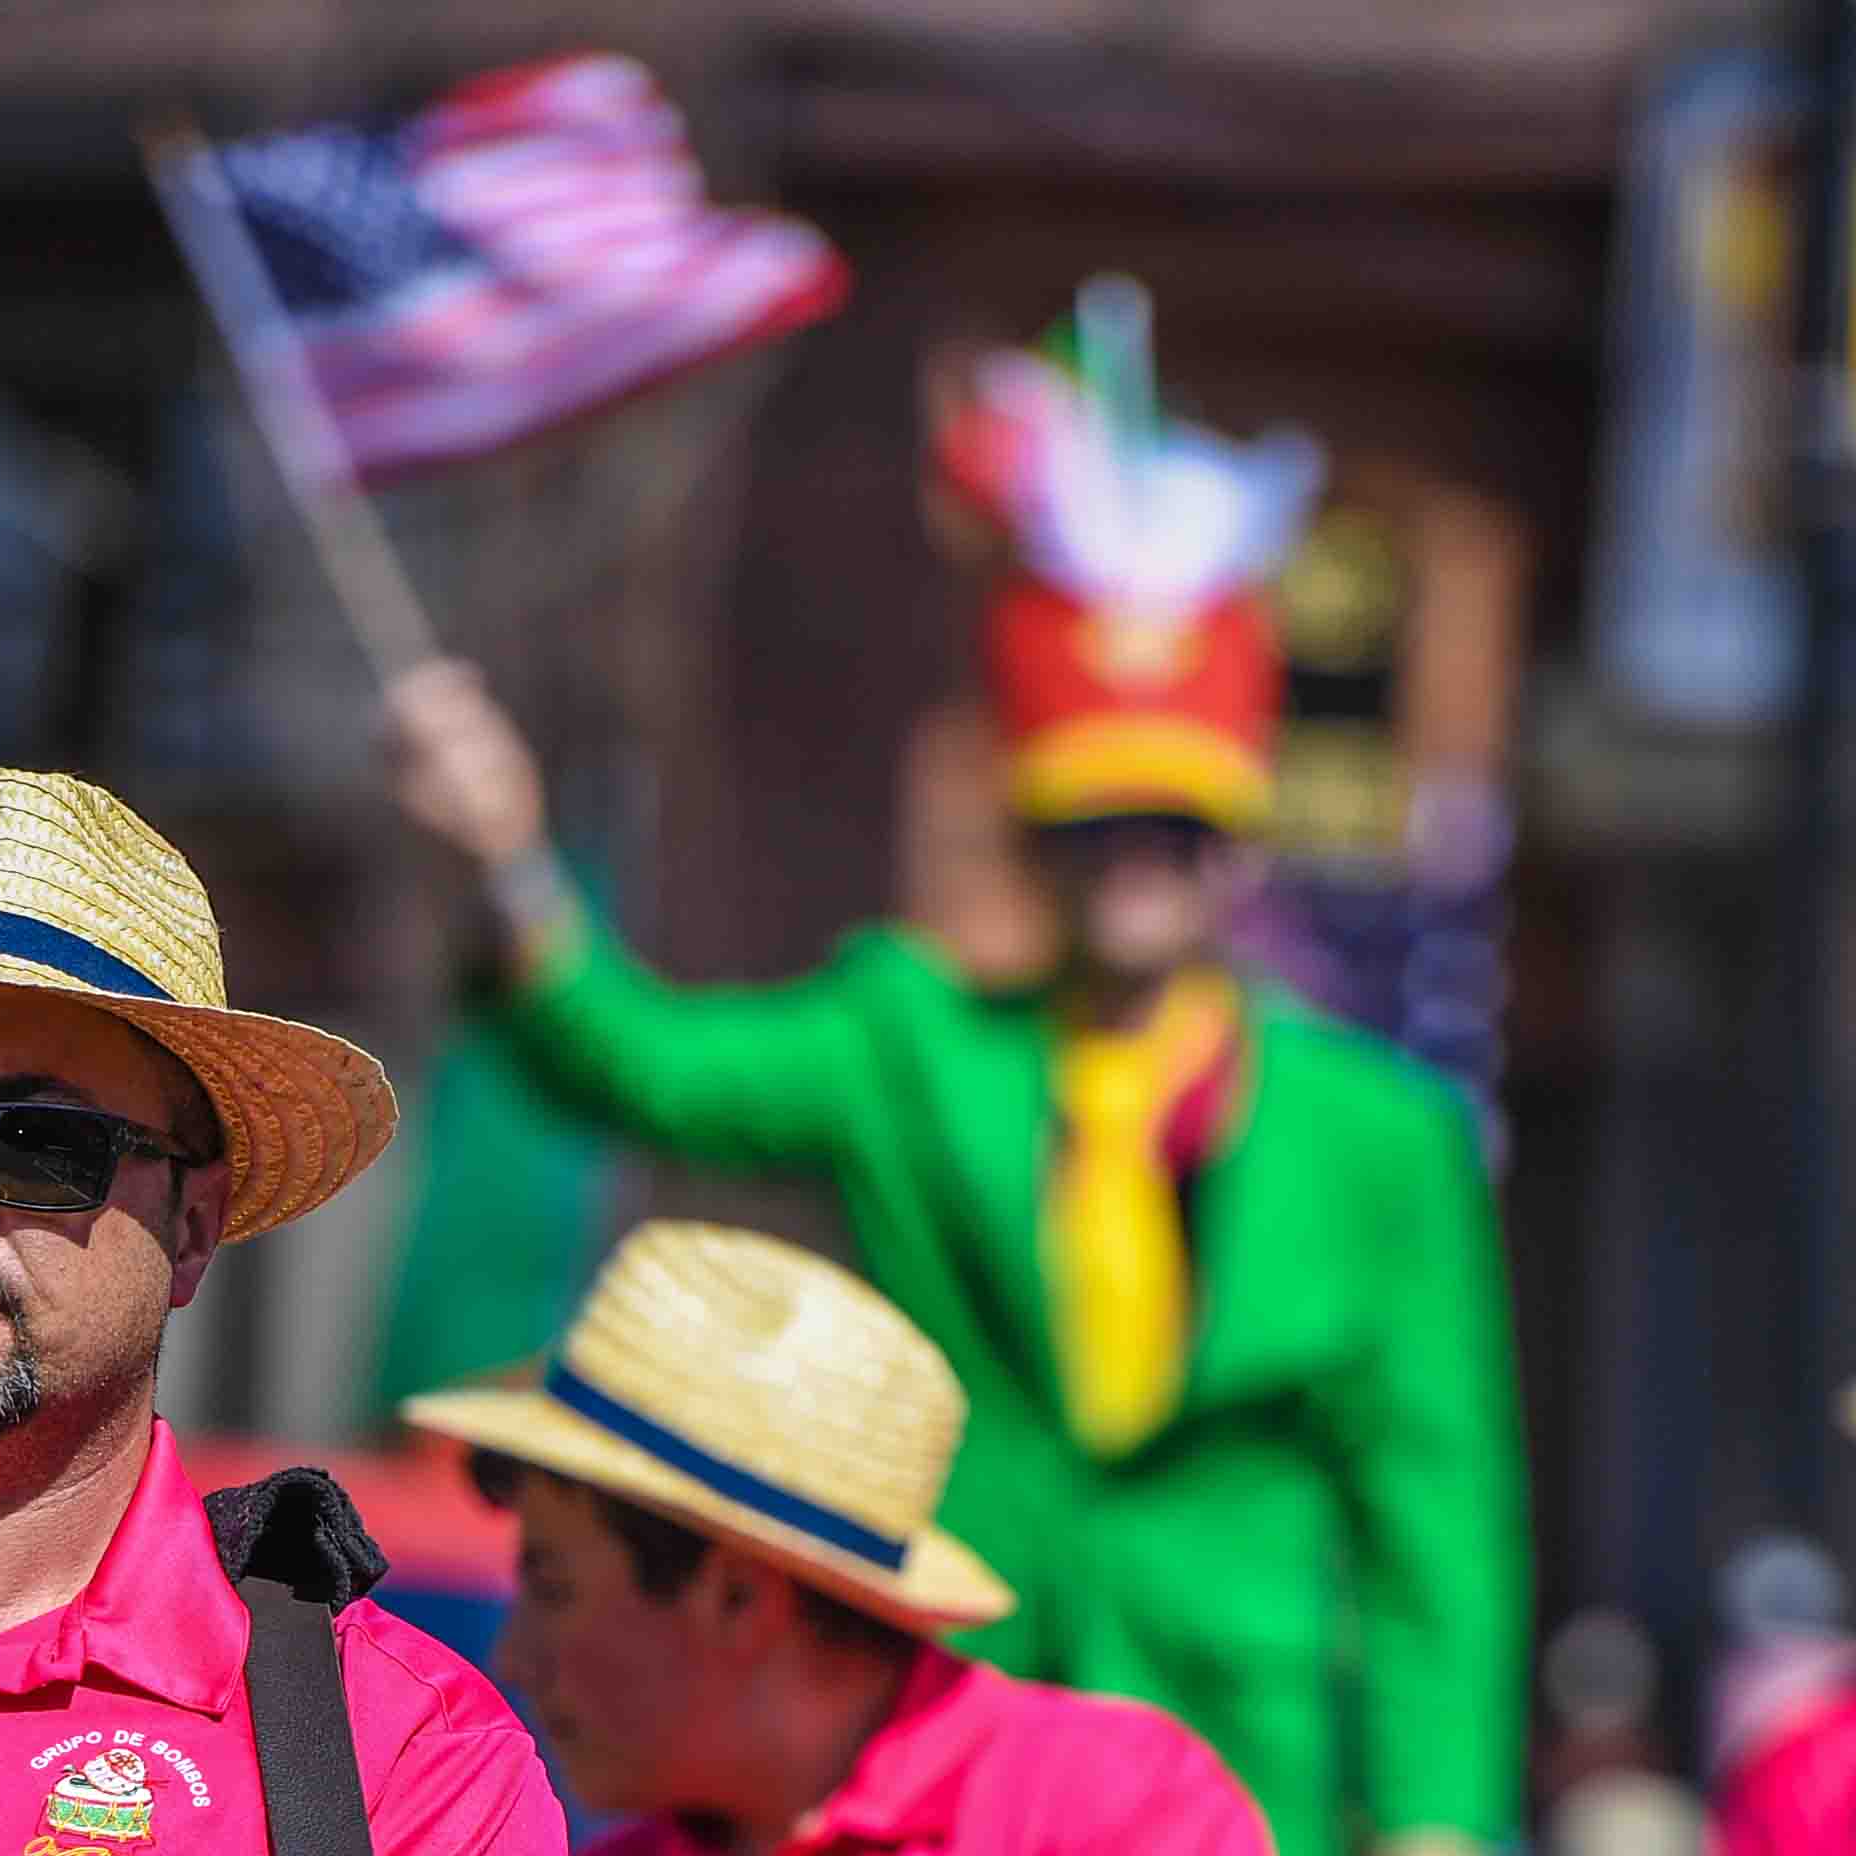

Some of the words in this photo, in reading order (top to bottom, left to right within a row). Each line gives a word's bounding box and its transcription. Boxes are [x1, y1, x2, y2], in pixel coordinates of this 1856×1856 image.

[30, 1731, 103, 1770] GRUPO
[113, 1730, 145, 1747] DE
[150, 1740, 212, 1807] BOMBOS
